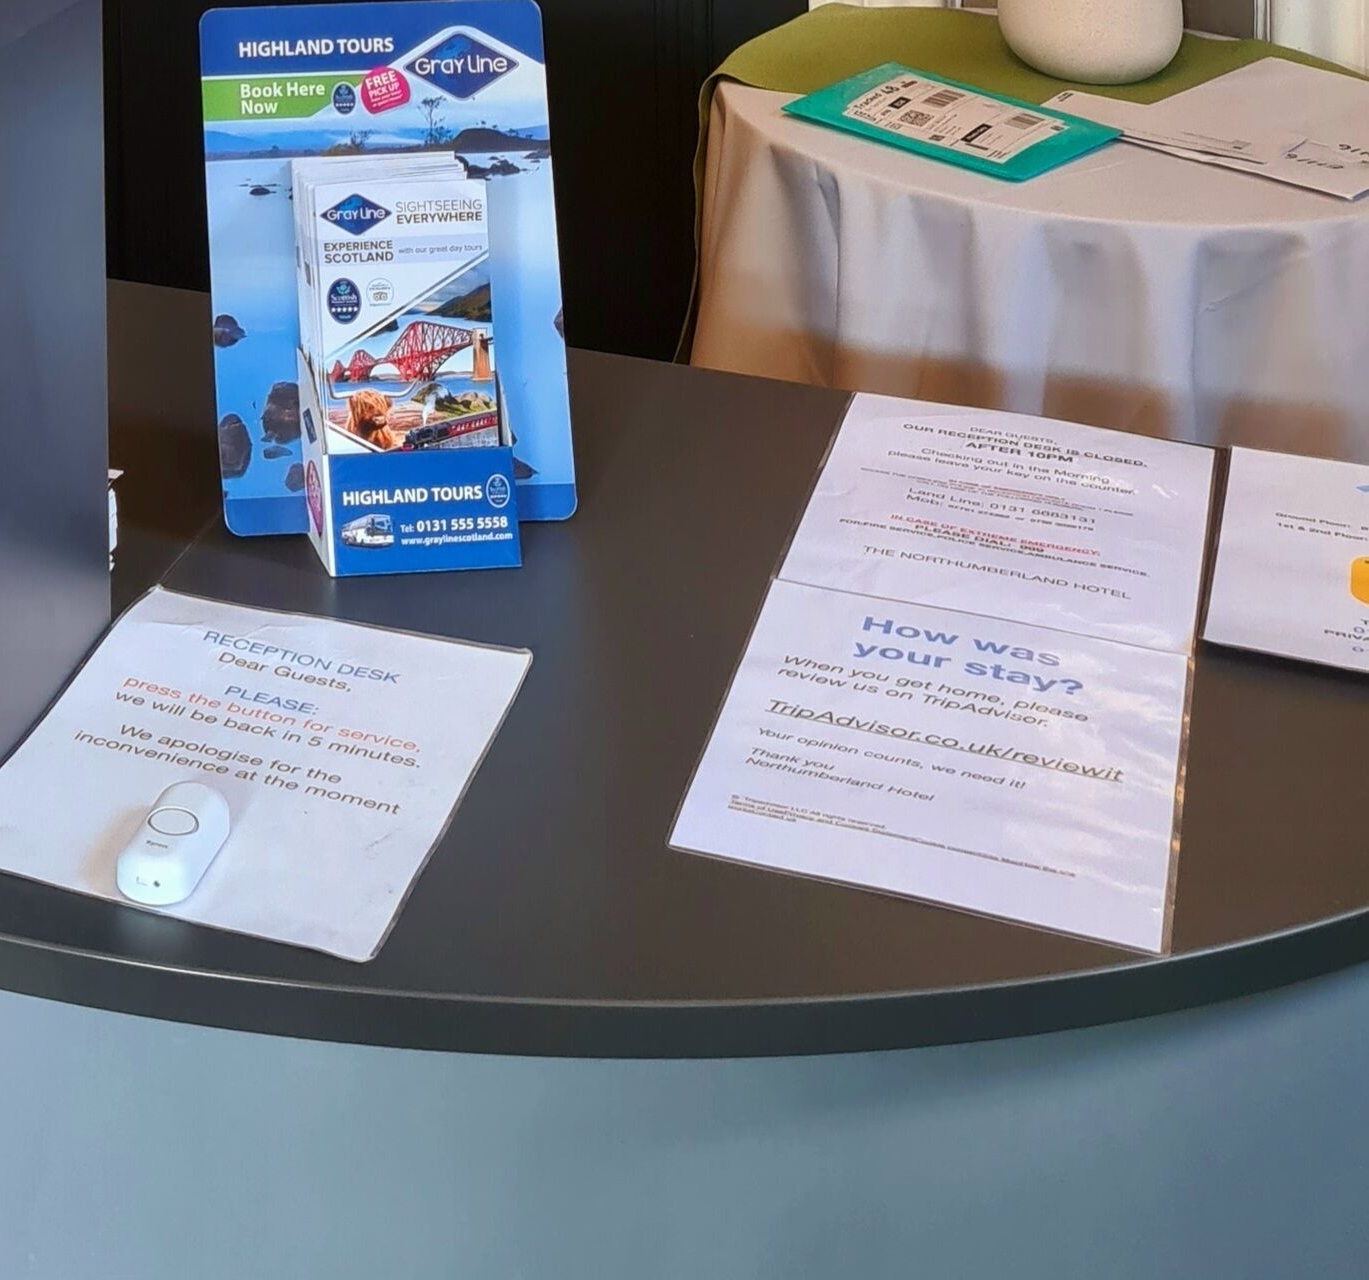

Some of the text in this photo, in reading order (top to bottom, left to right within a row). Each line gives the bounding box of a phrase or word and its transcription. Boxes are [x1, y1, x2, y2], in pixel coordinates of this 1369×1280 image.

[238, 37, 395, 58] HIGHLAND TOURS
[415, 56, 465, 75] Gray
[240, 81, 326, 99] Book Here
[365, 70, 398, 90] FREE
[368, 82, 400, 99] PICK UP
[240, 99, 279, 115] Now
[395, 199, 483, 213] SIGHTSEEING
[396, 211, 483, 225] EVERYWHERE
[324, 240, 394, 252] EXPERIENCE
[324, 251, 394, 264] SCOTLAND
[398, 246, 414, 254] with
[430, 245, 448, 255] great
[449, 243, 463, 253] day
[464, 243, 483, 251] tours
[903, 423, 934, 433] OUR
[937, 429, 1019, 447] RECEPTION
[1023, 441, 1062, 453] DESK
[970, 426, 1003, 437] DEAR
[966, 442, 1074, 464] AFTER 10PM
[887, 450, 932, 462] please
[935, 457, 970, 468] leave
[973, 464, 1004, 474] your
[1007, 468, 1031, 479] key
[1034, 474, 1052, 482] on
[1056, 477, 1077, 486] the
[921, 448, 1110, 485] Checking out in the Morning
[342, 485, 483, 506] HIGHLAND TOURS
[909, 487, 946, 500] Land
[989, 502, 1026, 514] 0131
[400, 516, 508, 533] Tel: 0131 555 5558
[906, 517, 939, 528] CASE
[940, 523, 958, 531] OF
[960, 527, 1018, 543] EXTREME
[914, 524, 970, 539] PLEASE
[401, 532, 513, 547] www.graylinescotland.com
[863, 544, 1131, 601] THE NORTHUMBERLAND HOTEL
[861, 615, 1061, 668] How was
[203, 629, 401, 684] RECEPTION DESK
[852, 641, 1084, 696] your stay?
[218, 651, 352, 692] Dear Guests,
[225, 685, 320, 716] PLEASE:
[777, 666, 1050, 729] review us on TripAdvisor.
[783, 655, 1089, 723] When you get home, please
[124, 677, 183, 701] press
[188, 691, 222, 708] the
[226, 699, 297, 726] button
[303, 719, 334, 733] for
[115, 692, 421, 768] we will be back in 5 minutes.
[765, 698, 1125, 784] TripAdvisor.co.uk/reviewit
[121, 723, 342, 784] We apologise for the
[750, 746, 836, 772] Thank you
[757, 726, 795, 742] Your
[796, 734, 859, 757] opinion
[863, 748, 924, 771] counts,
[930, 764, 957, 776] we
[961, 770, 1007, 788] need
[74, 729, 401, 815] inconvenience at the moment
[745, 756, 936, 802] Northumberland Hotel
